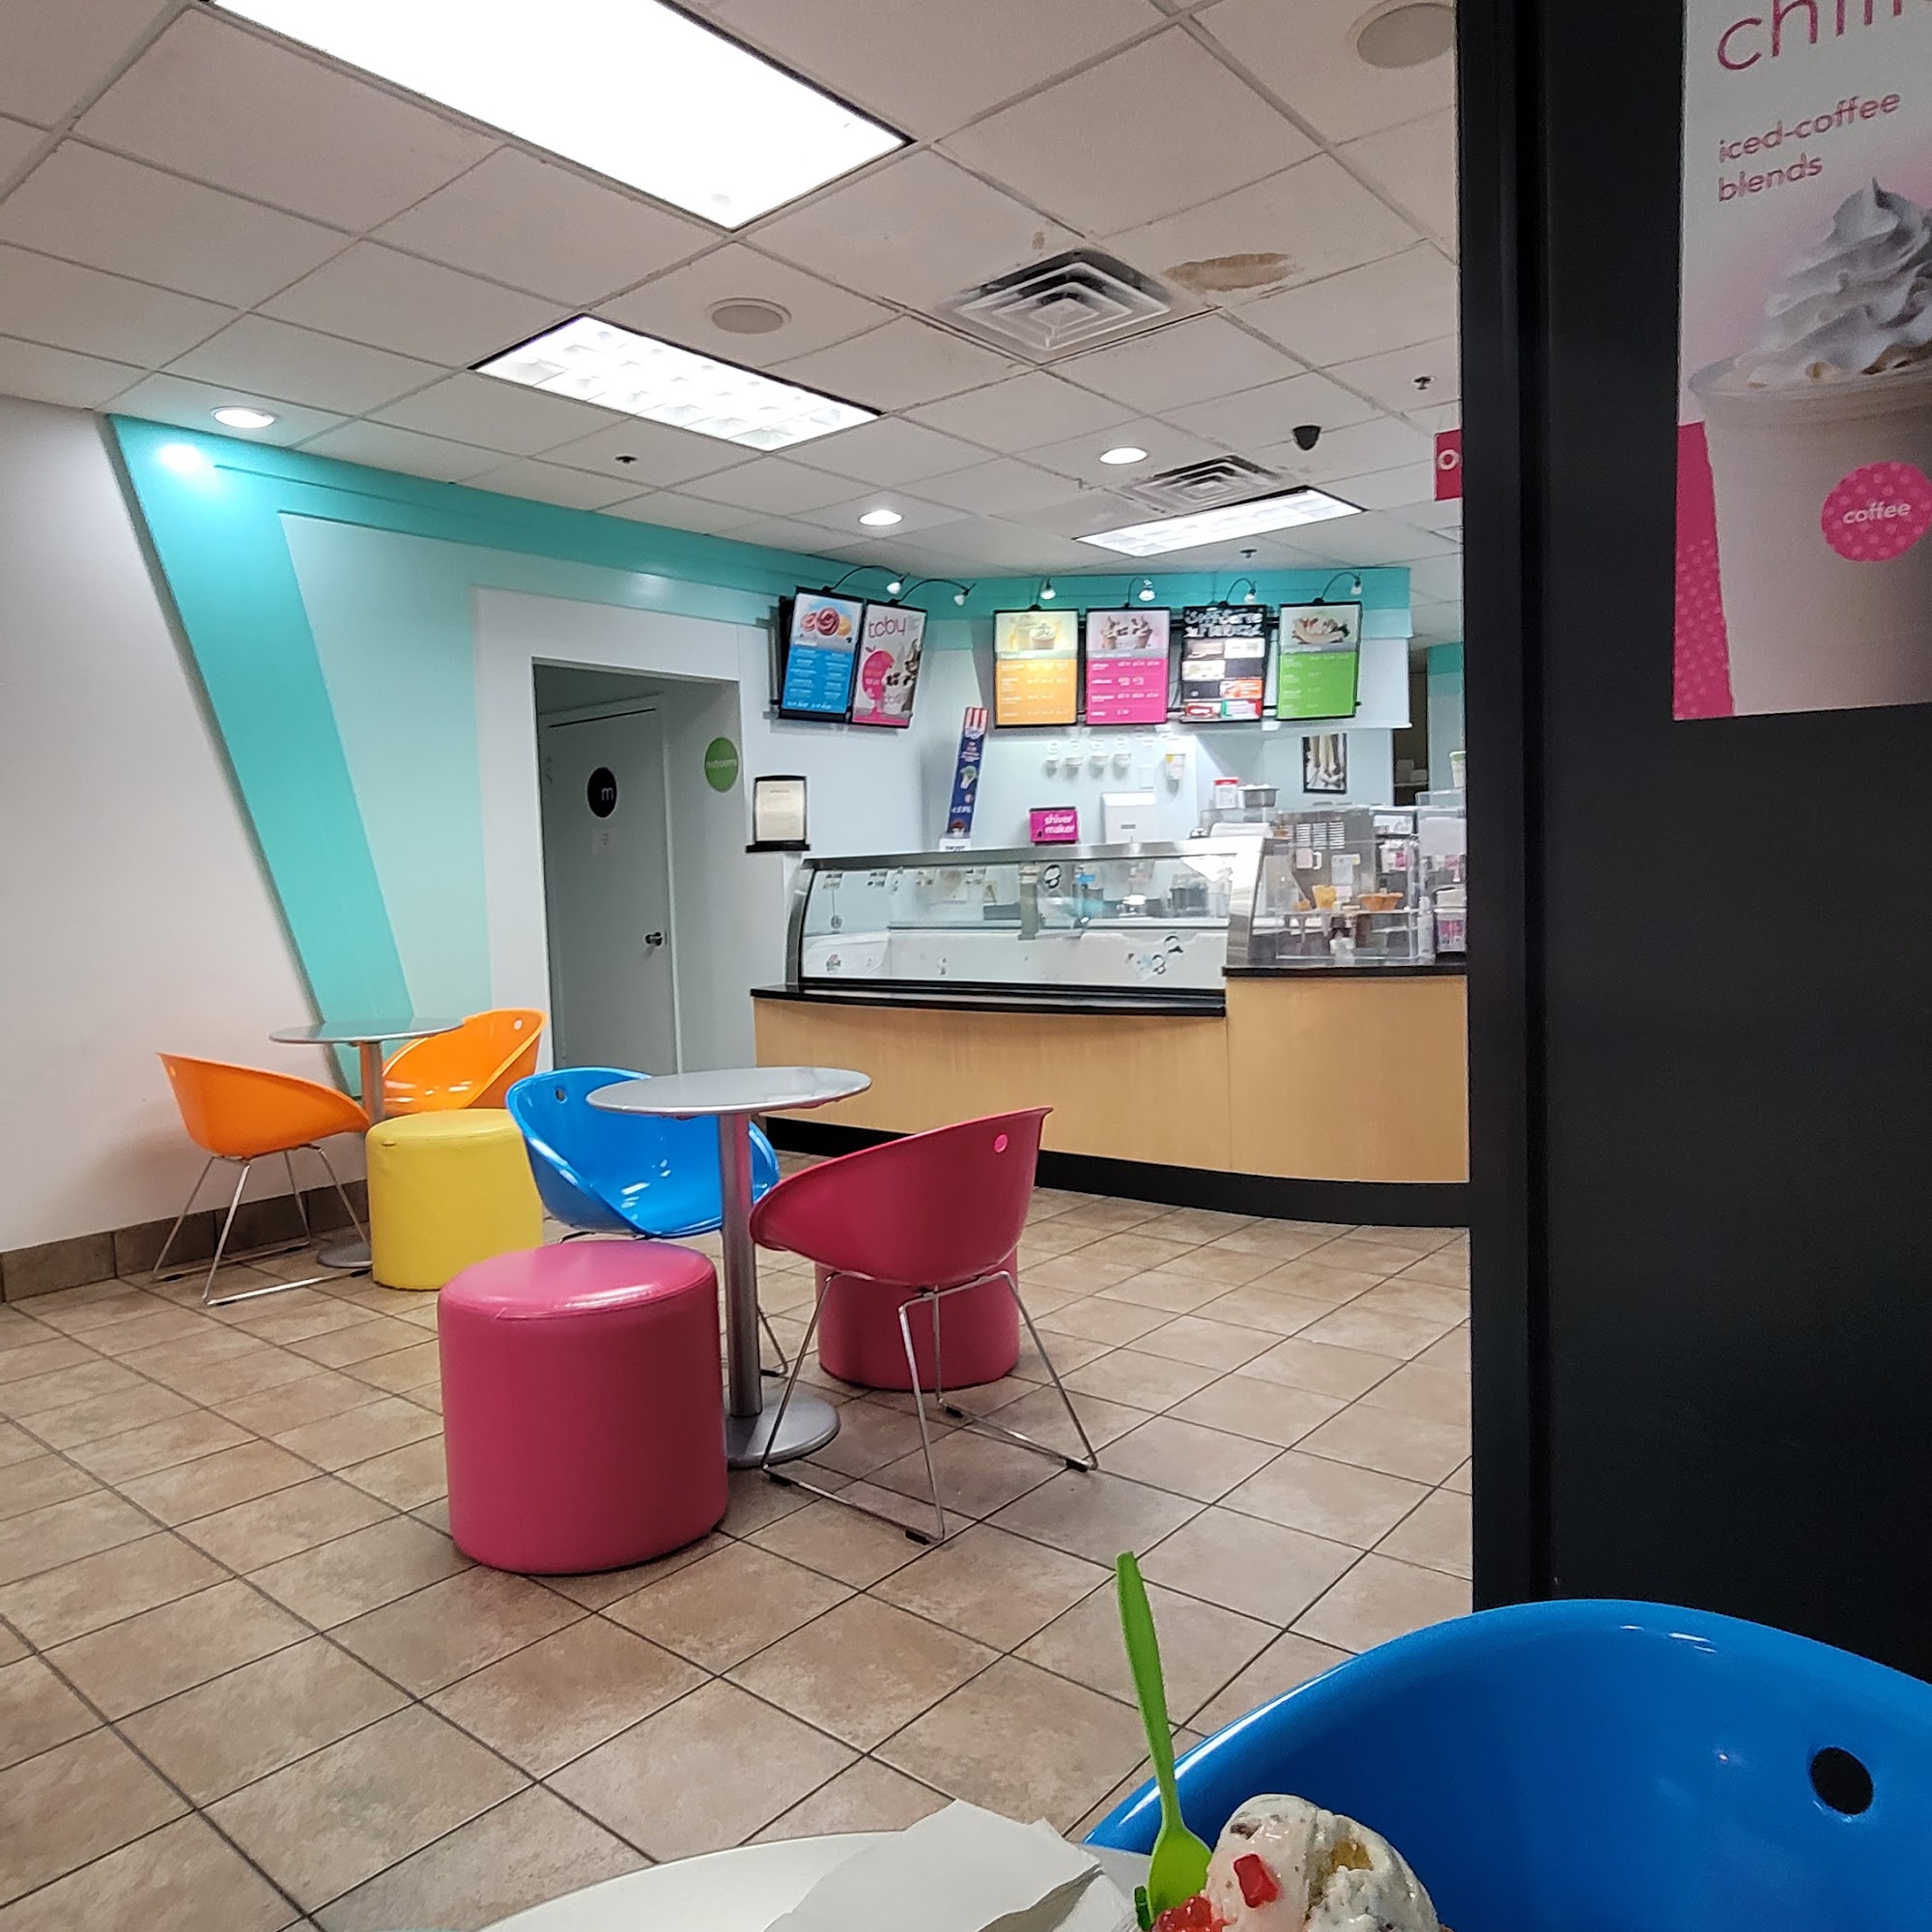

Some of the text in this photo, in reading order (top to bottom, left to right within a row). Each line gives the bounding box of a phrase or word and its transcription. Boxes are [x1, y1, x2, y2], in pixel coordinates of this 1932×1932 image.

[1719, 93, 1901, 162] iced-coffee
[1719, 153, 1823, 202] blends
[1842, 501, 1912, 524] coffee
[601, 787, 614, 801] m
